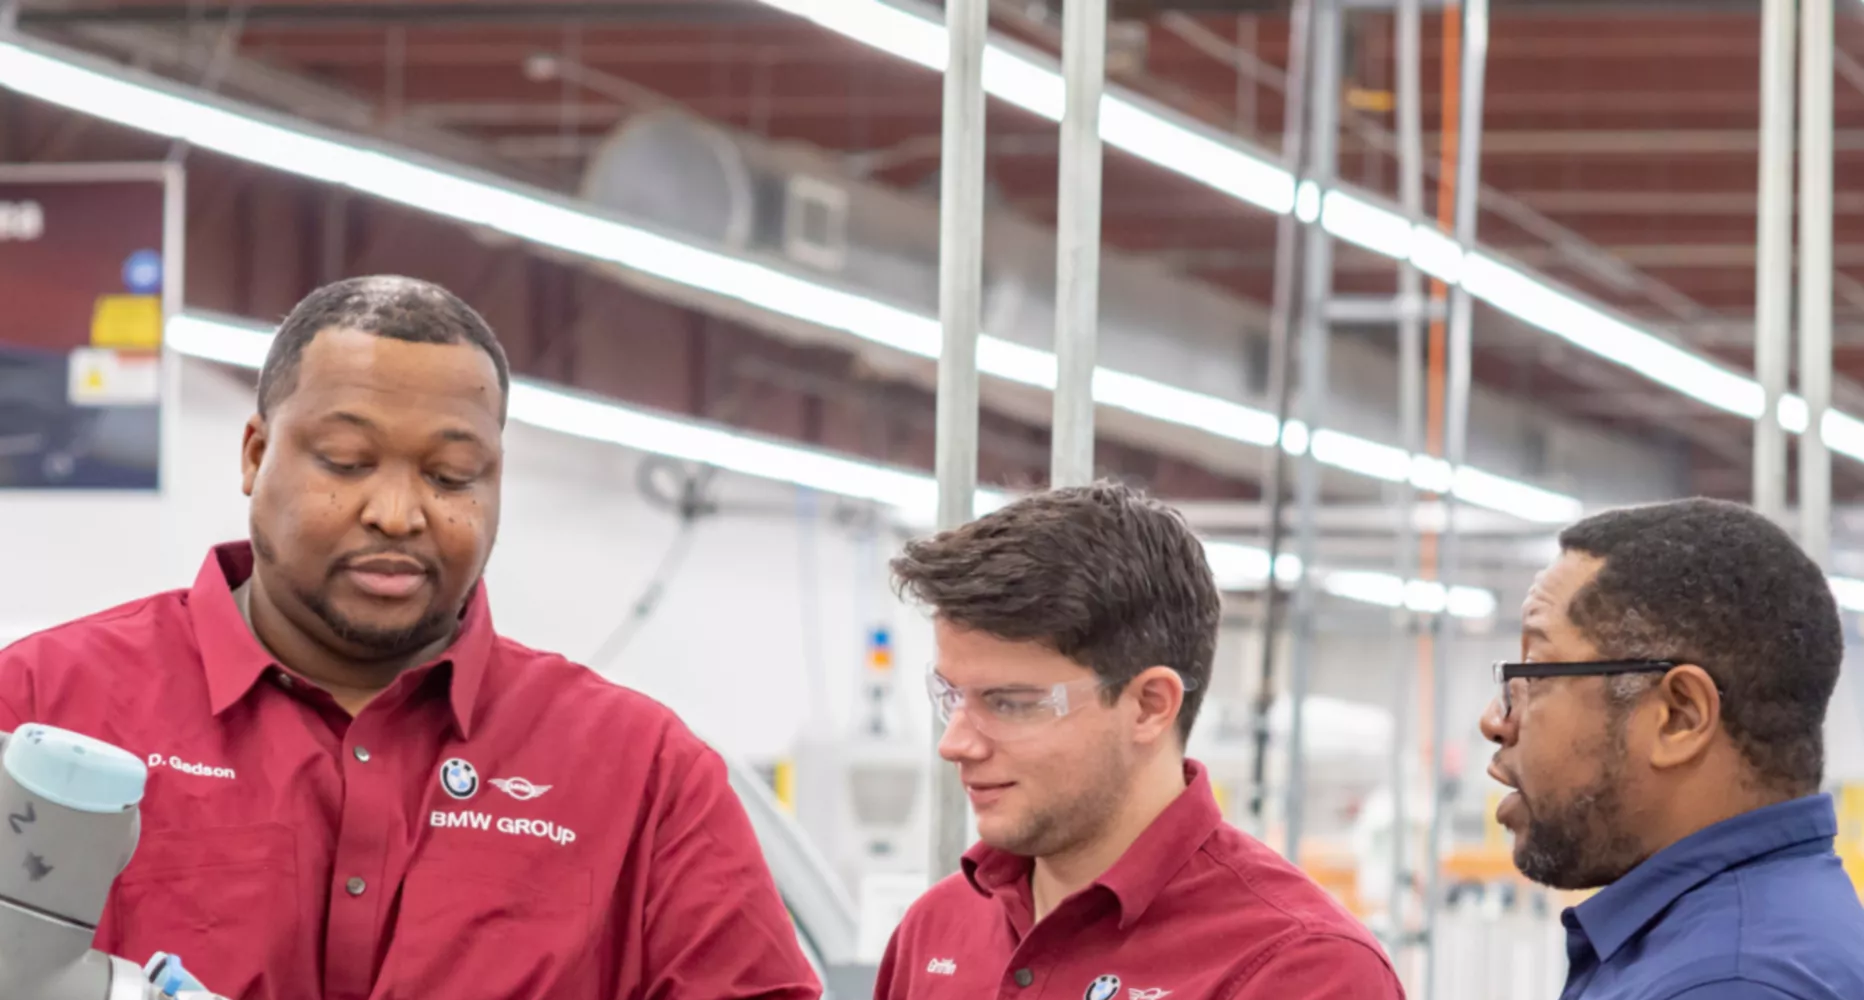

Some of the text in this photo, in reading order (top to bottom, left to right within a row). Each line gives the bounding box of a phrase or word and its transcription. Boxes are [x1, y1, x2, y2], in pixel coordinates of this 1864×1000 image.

[147, 752, 236, 779] D. Gadson
[429, 810, 577, 846] BMW GROUP
